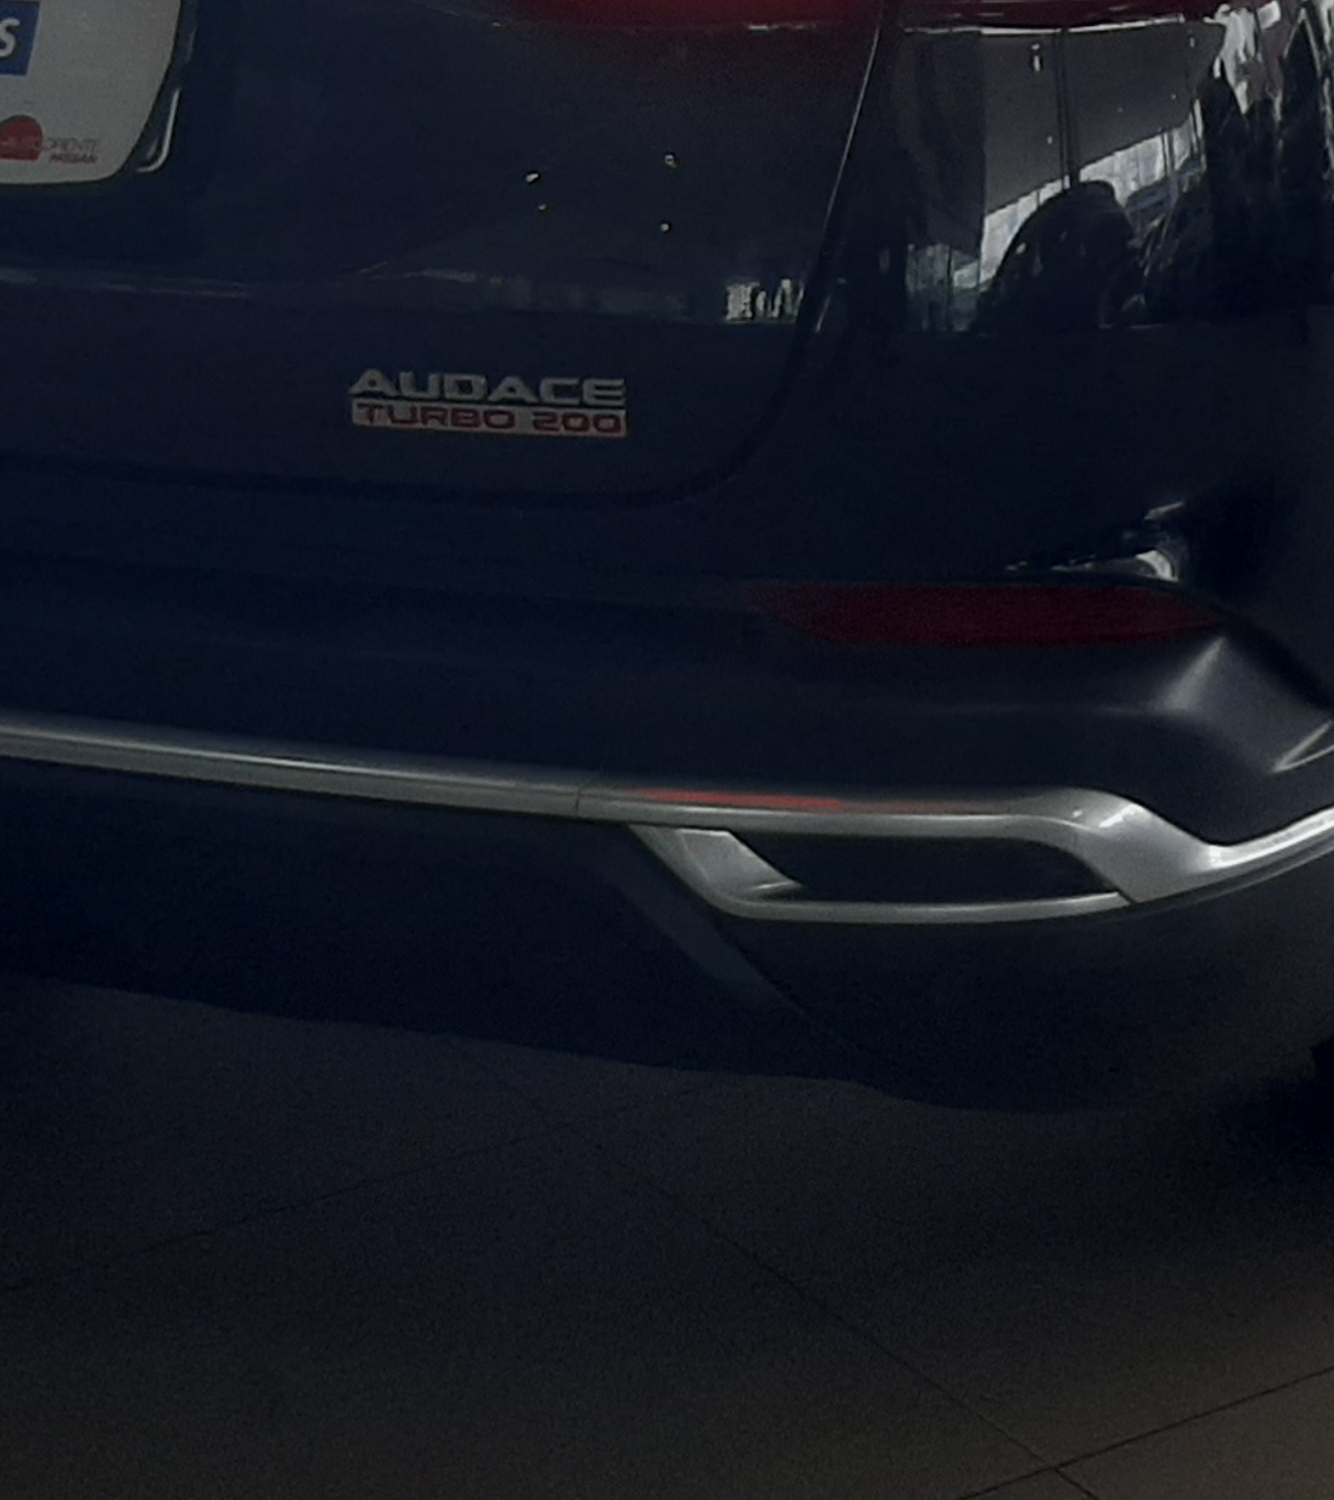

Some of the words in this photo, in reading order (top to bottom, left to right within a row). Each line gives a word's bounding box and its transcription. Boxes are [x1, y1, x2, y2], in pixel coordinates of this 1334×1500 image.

[348, 368, 627, 408] AUDACE
[357, 402, 515, 430] TURBO
[532, 411, 621, 434] 200
